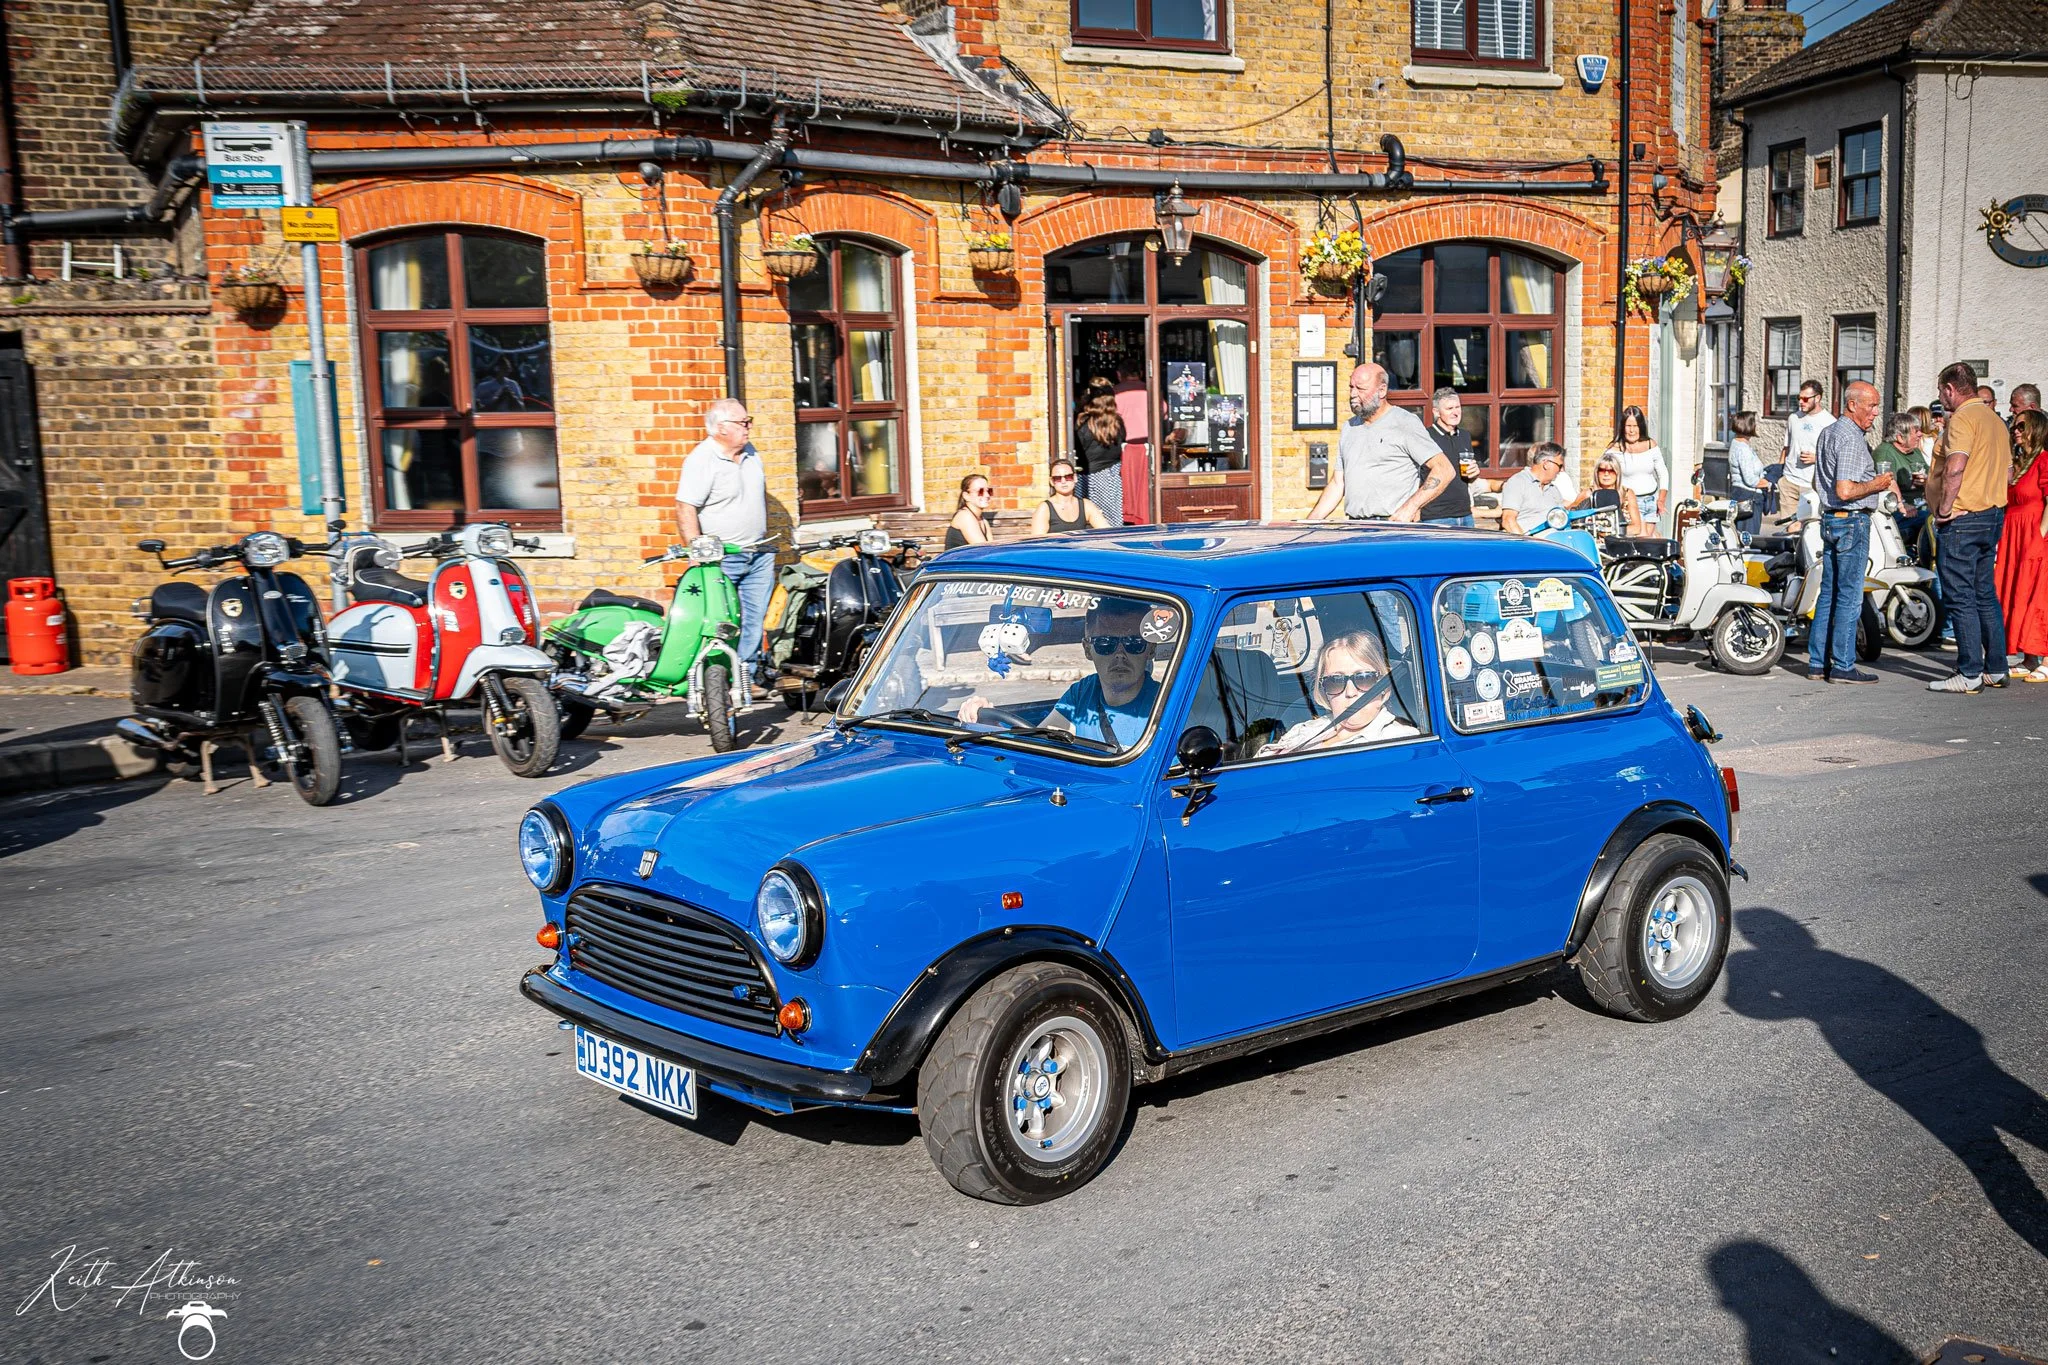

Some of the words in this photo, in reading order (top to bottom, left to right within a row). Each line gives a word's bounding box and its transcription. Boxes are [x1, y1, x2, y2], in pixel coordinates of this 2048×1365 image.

[243, 153, 265, 162] Stop
[220, 170, 237, 178] The
[940, 583, 974, 595] SMALL
[976, 583, 1008, 597] CARS
[1010, 587, 1034, 601] BIG
[1039, 588, 1101, 610] HEARTS
[1514, 674, 1540, 685] BRANDS
[586, 1035, 639, 1091] D392
[646, 1057, 691, 1110] NKK
